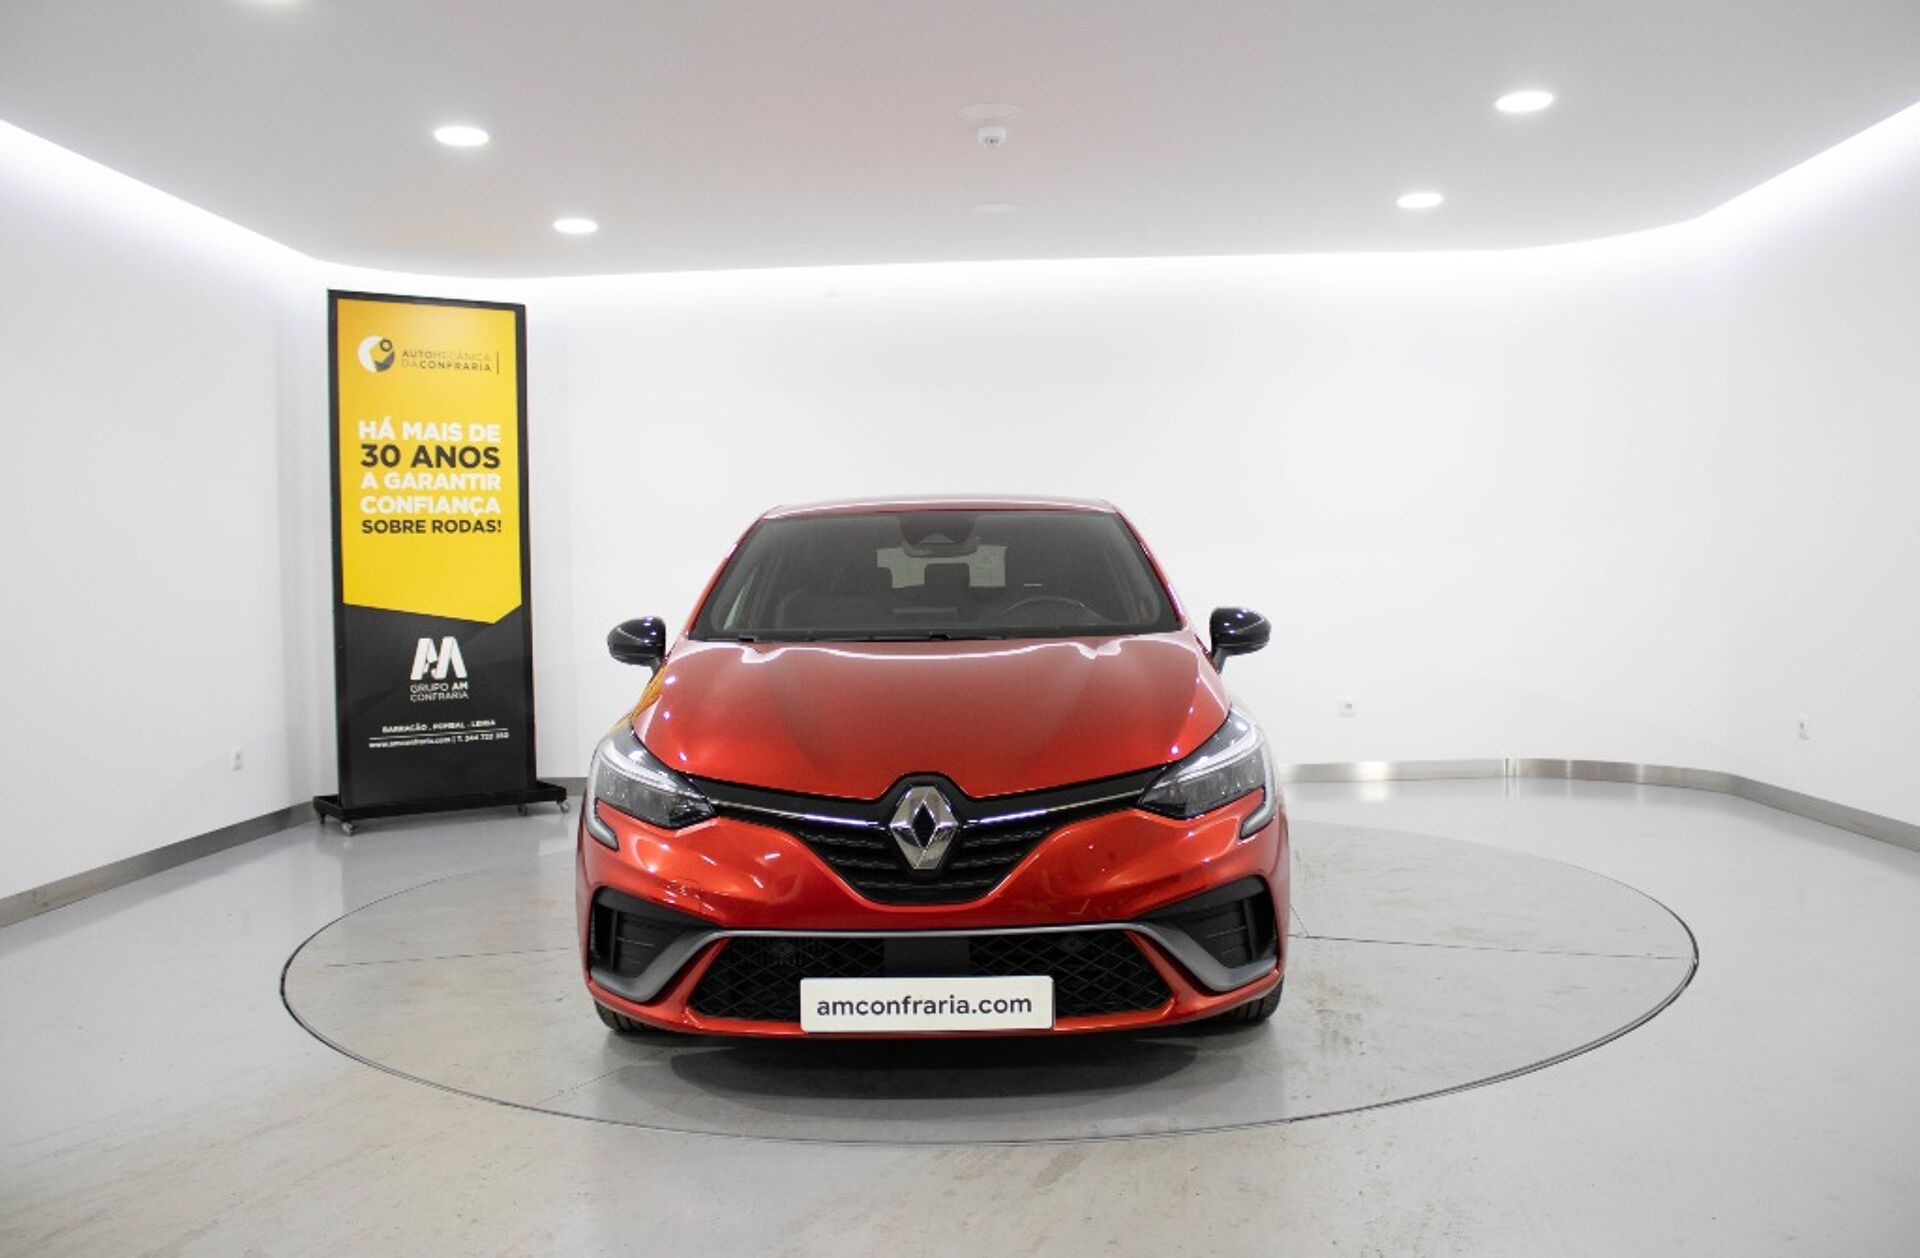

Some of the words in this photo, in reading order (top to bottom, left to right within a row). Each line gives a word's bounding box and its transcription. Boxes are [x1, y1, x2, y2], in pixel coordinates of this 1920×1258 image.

[358, 416, 396, 442] HÁ
[402, 421, 462, 442] MAIS
[469, 424, 501, 442] DE
[361, 444, 401, 468] 30
[411, 446, 500, 468] ANOS
[361, 472, 378, 489] A
[384, 472, 501, 491] GARANTIR
[360, 495, 501, 516] CONFIANÇA
[361, 519, 426, 534] SOBRE
[432, 519, 502, 533] RODAS!
[410, 683, 449, 693] GRUPO
[452, 681, 468, 691] AM
[410, 691, 469, 702] CONFRARIA
[817, 995, 1032, 1016] amconfraria.com
